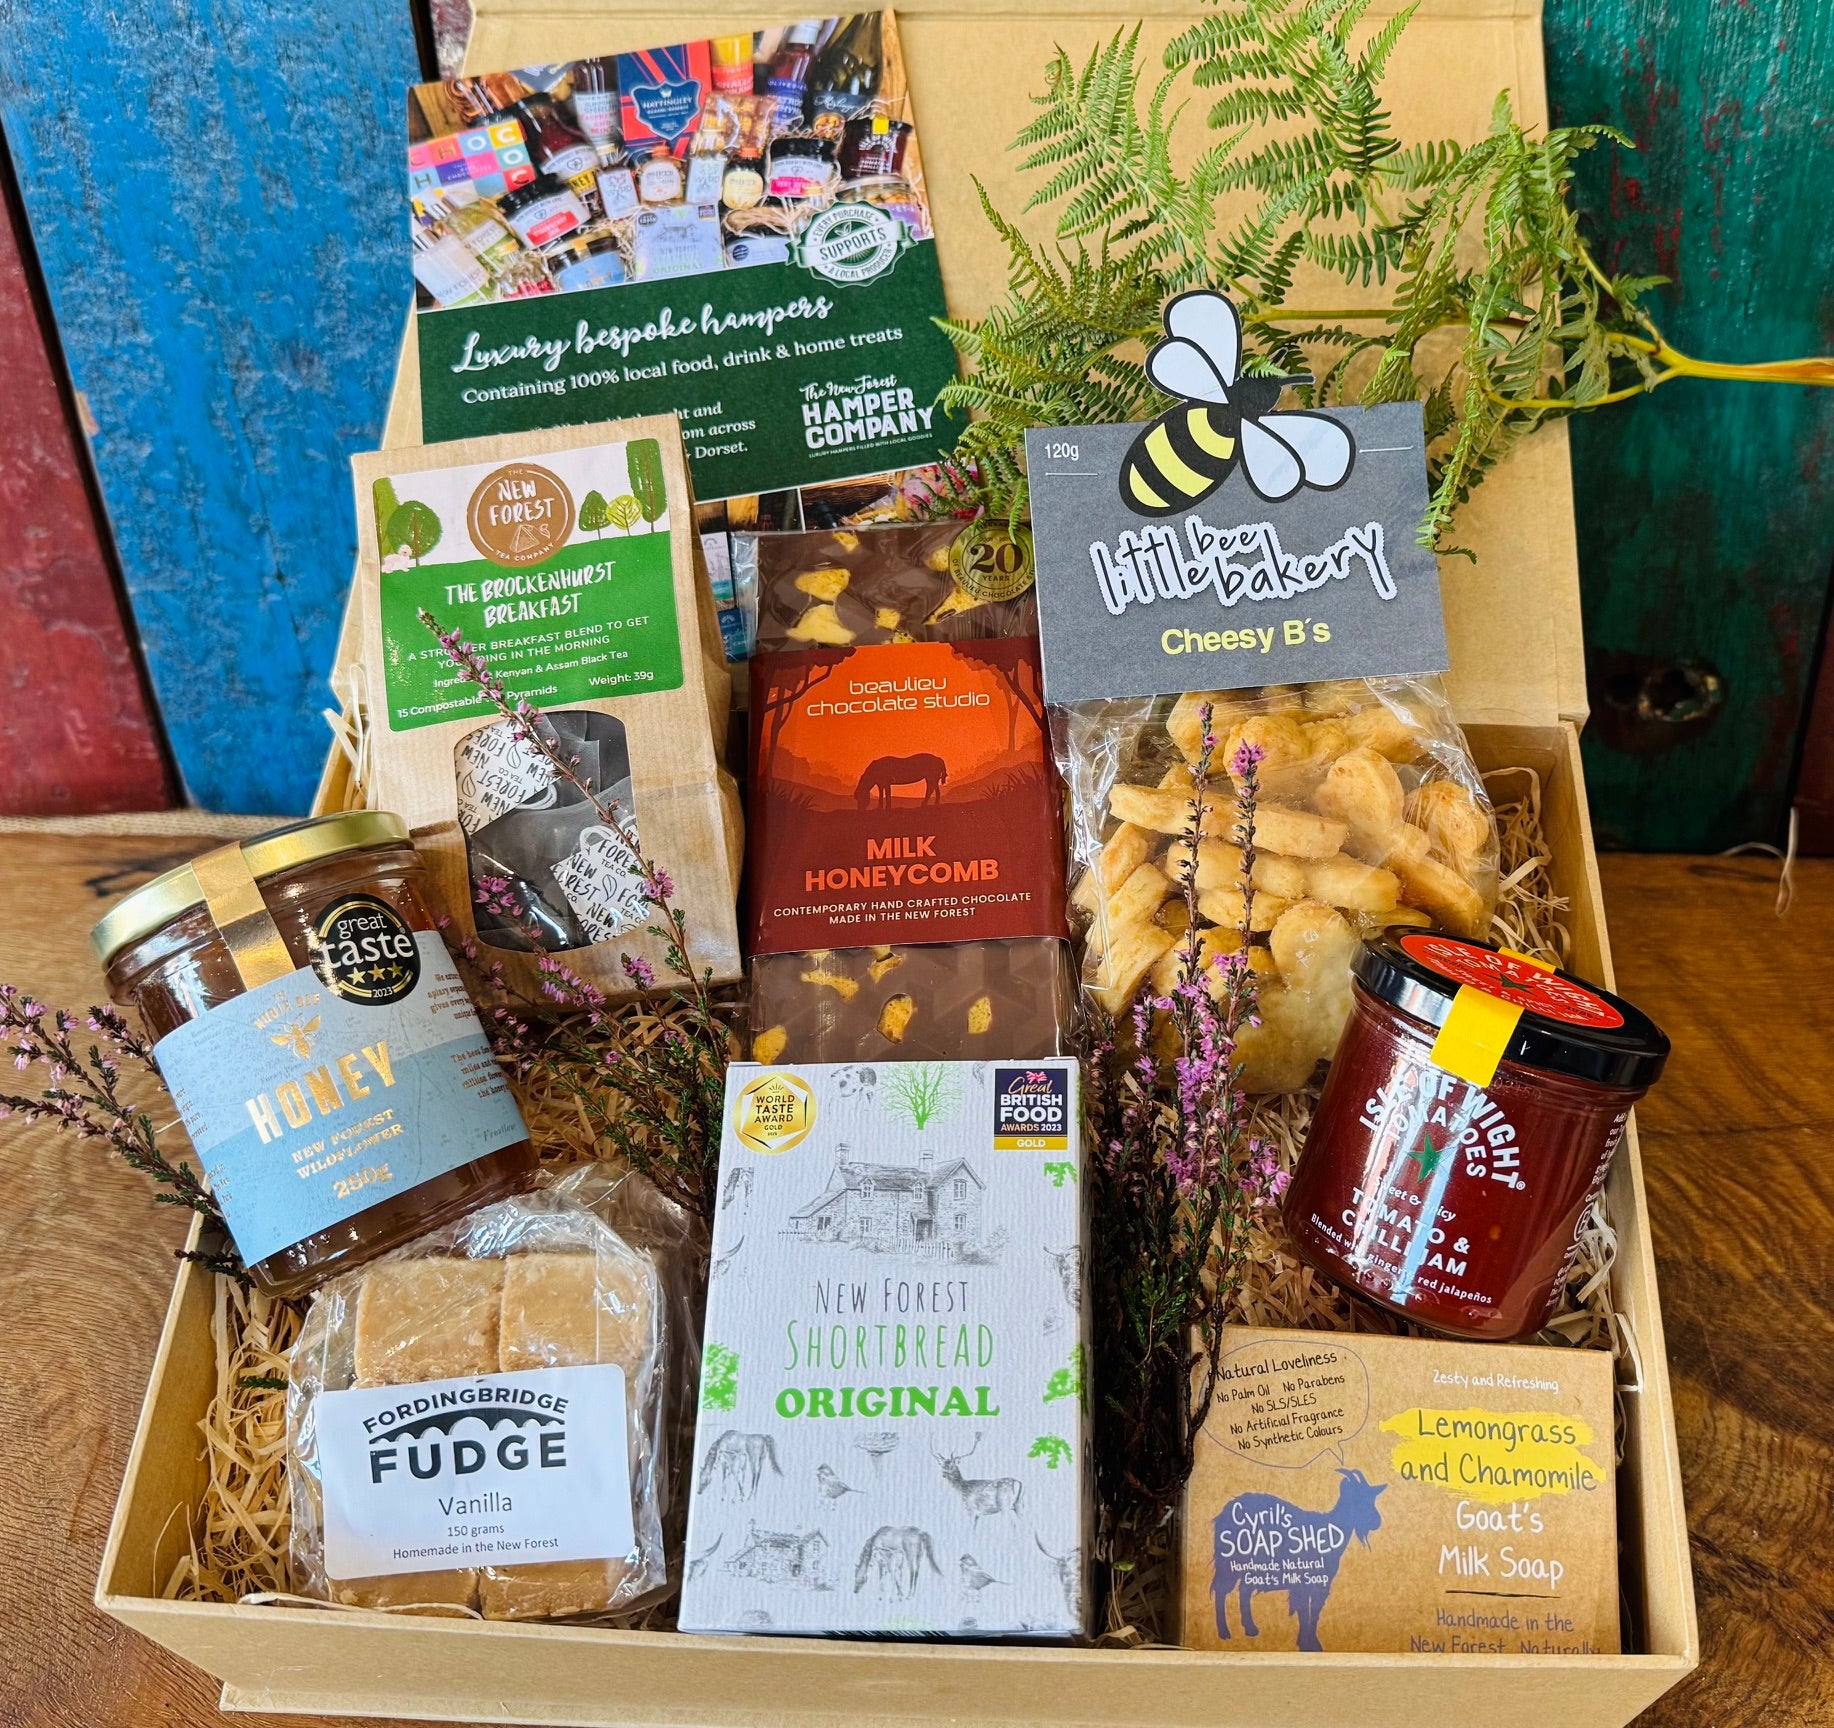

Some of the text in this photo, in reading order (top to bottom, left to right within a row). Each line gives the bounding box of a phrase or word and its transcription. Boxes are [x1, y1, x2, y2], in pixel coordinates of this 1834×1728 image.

[814, 209, 874, 236] EVERY PURCHASE
[820, 227, 886, 261] SUPPORTS
[836, 248, 892, 279] LOCAL PRODUCER
[451, 295, 834, 374] Luxury bespoke hampers
[463, 326, 904, 404] Containing 100% local food, drink & home treats
[800, 374, 897, 401] The New Forest
[693, 401, 723, 418] and
[802, 387, 915, 426] HAMPER
[708, 419, 756, 436] across
[805, 406, 934, 449] COMPANY
[694, 441, 748, 459] Dorset.
[830, 447, 856, 455] HAMPERS
[908, 433, 932, 441] GOODIES
[1044, 443, 1080, 461] 120g
[497, 479, 537, 500] NEW
[489, 498, 555, 527] FOREST
[495, 542, 555, 562] TEA COMPANY
[1191, 522, 1258, 554] bee
[969, 544, 1023, 573] 20
[1097, 527, 1392, 608] little bakery
[444, 561, 616, 606] THE BROCKENHURST
[954, 569, 1028, 598] BEAULIEU CHOCOLATE
[484, 593, 583, 629] BREAKFAST
[408, 653, 417, 662] A
[491, 631, 561, 652] BREAKFAST
[565, 624, 603, 640] BLEND
[606, 621, 623, 630] TO
[627, 616, 650, 628] GET
[511, 650, 523, 659] IN
[528, 647, 550, 656] THE
[554, 634, 610, 652] MORNING
[1161, 625, 1274, 655] Cheesy
[496, 650, 629, 679] Kenyan & Assam Black Tea
[588, 671, 654, 687] Weight: 39g
[849, 675, 947, 697] beaulieu
[396, 684, 558, 718] 15 Compostable Pyramids
[807, 691, 991, 718] chocolate studio
[866, 836, 936, 861] MILK
[805, 858, 999, 892] HONEYCOMB
[773, 892, 1032, 918] CONTEMPORARY HAND CRAFTED CHOCOLATE
[829, 907, 976, 925] MADE IN THE NEW FOREST
[337, 913, 388, 939] great
[321, 932, 414, 969] taste
[373, 987, 393, 998] 2023
[246, 1040, 396, 1144] HONEY
[756, 1095, 795, 1103] WORLD
[1000, 1094, 1062, 1106] BRITISH
[1008, 1076, 1053, 1096] Great
[1418, 1071, 1458, 1100] OF
[754, 1115, 793, 1123] AWARD
[756, 1104, 794, 1114] TASTE
[1000, 1106, 1062, 1122] FOOD
[291, 1108, 394, 1164] NEW FOREST
[1001, 1124, 1061, 1132] AWARDS 2023
[1383, 1104, 1488, 1179] TOMATOES
[296, 1123, 404, 1179] WILDFLOWER
[1017, 1139, 1046, 1147] GOLD
[333, 1163, 393, 1199] 250g
[1409, 1194, 1422, 1205] &
[1310, 1213, 1343, 1243] Blended
[1418, 1275, 1438, 1290] red
[1439, 1282, 1492, 1304] jalapeños
[1453, 1237, 1470, 1255] &
[1417, 1249, 1467, 1277] JAM
[815, 1277, 969, 1314] NEW FOREST
[784, 1318, 994, 1371] SHORTBREAD
[1215, 1350, 1338, 1381] Natural Loveliness
[1216, 1373, 1346, 1404] No Palm Oil No Parabens
[1433, 1369, 1560, 1395] Zesty and Refreshing
[362, 1387, 569, 1434] FORDINGBRIDGE
[775, 1385, 1000, 1419] ORIGINAL
[1251, 1393, 1318, 1414] No SLS/SLES
[1230, 1406, 1345, 1435] No Artificial Fragrance
[1418, 1409, 1576, 1453] Lemongrass
[1238, 1424, 1344, 1451] No Synthetic Colours
[370, 1431, 567, 1484] FUDGE
[1400, 1452, 1598, 1491] and Chamomile
[438, 1491, 513, 1516] Vanilla
[1232, 1501, 1293, 1532] Cyril's
[1456, 1500, 1544, 1533] Goat's
[447, 1524, 505, 1538] 150 grams
[1219, 1522, 1345, 1559] SOAP SHED
[392, 1537, 558, 1559] Homemade in the New Forest
[1230, 1556, 1325, 1572] Handmade Natural
[1439, 1546, 1564, 1590] Milk Soap
[1244, 1571, 1329, 1587] Goat's Milk Soap
[1436, 1608, 1573, 1632] Handmade in the
[1410, 1635, 1445, 1653] New
[1451, 1636, 1505, 1653] Forest
